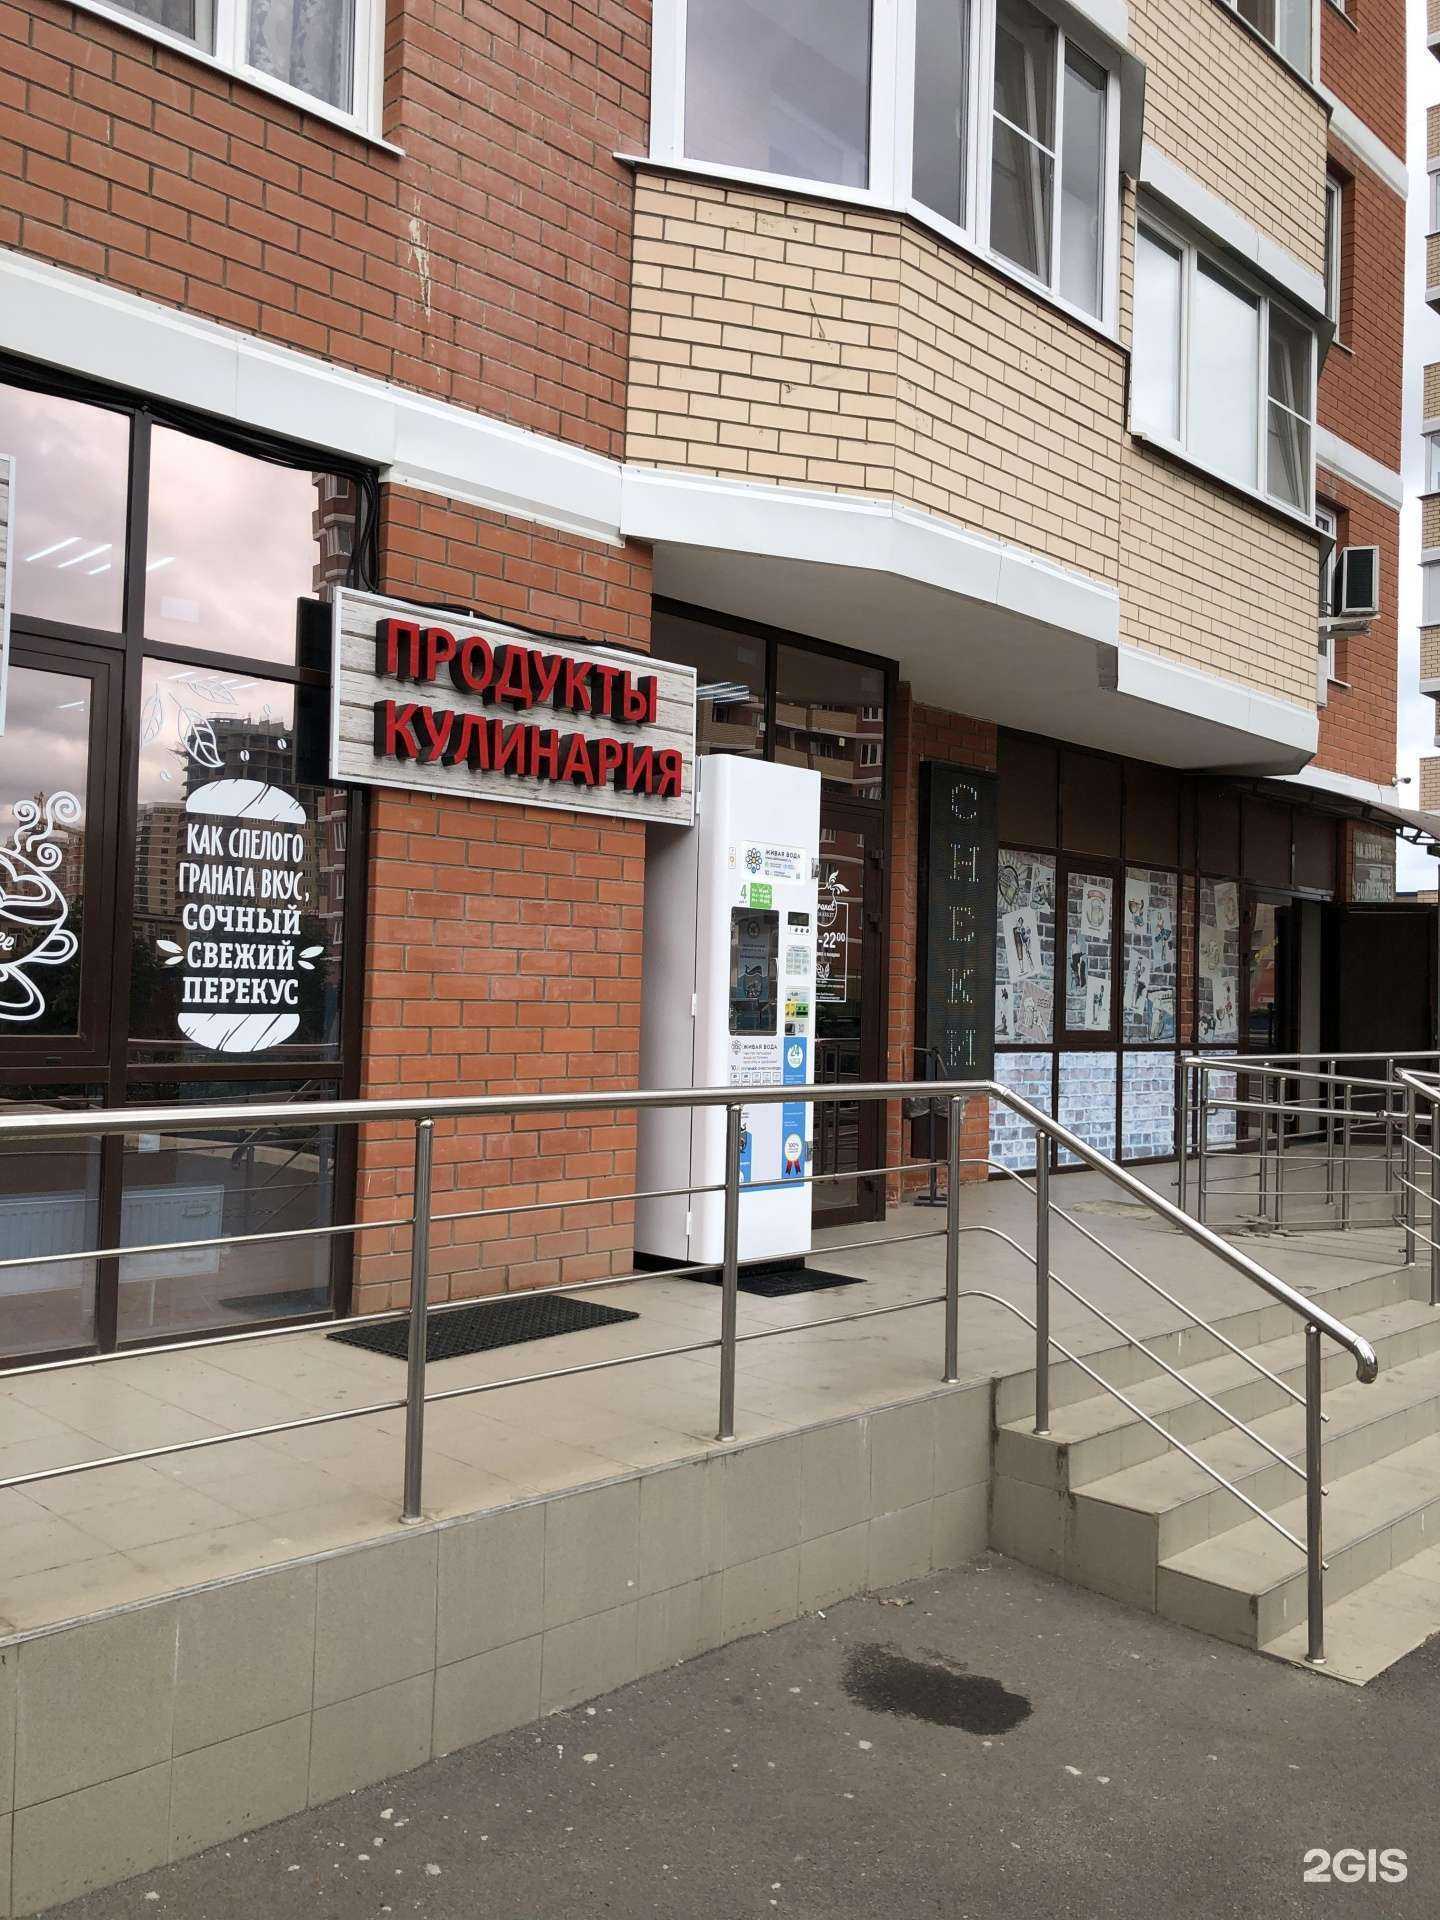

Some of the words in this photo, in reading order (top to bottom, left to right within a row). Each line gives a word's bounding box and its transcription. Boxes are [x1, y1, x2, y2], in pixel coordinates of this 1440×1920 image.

[377, 617, 658, 723] ПРОДУКТЫ
[375, 699, 682, 798] КУЛИНАРИЯ
[186, 823, 224, 856] КАК
[228, 827, 304, 863] СПЕЛОГО
[765, 848, 785, 858] ЖИВАЯ
[786, 851, 801, 860] ВОДА
[178, 862, 255, 898] ГРАНАТА
[261, 868, 310, 902] ВКУС,
[182, 903, 302, 935] СОЧНЫЙ
[187, 940, 295, 971] СВЕЖИЙ
[181, 976, 299, 1005] ПЕРЕКУС
